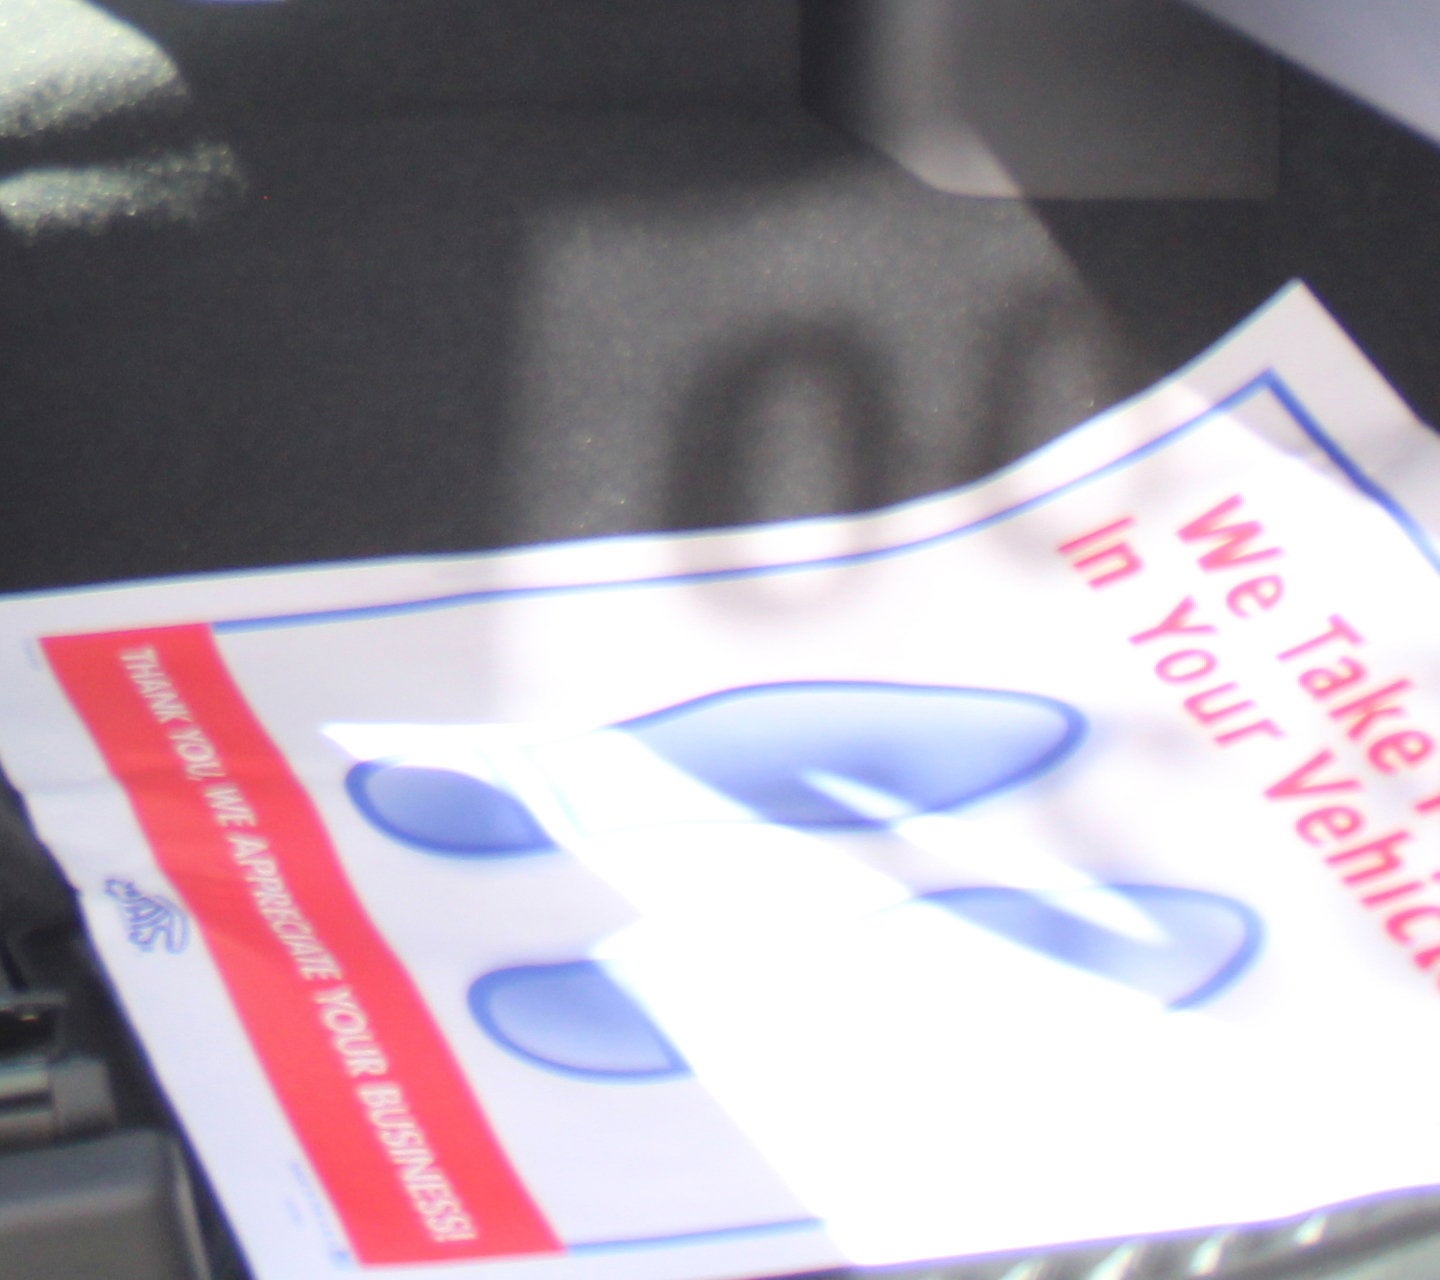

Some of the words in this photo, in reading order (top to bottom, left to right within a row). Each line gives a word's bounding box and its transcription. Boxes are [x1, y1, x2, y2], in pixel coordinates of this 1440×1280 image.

[120, 646, 190, 725] THANK
[1057, 516, 1144, 589] In
[1129, 596, 1284, 746] Your
[1178, 494, 1285, 618] We
[1277, 614, 1436, 774] Take
[205, 783, 256, 828] WE
[229, 832, 342, 982] APPRECIATE
[314, 985, 389, 1078] YOUR
[358, 1082, 477, 1243] BUSINESS!
